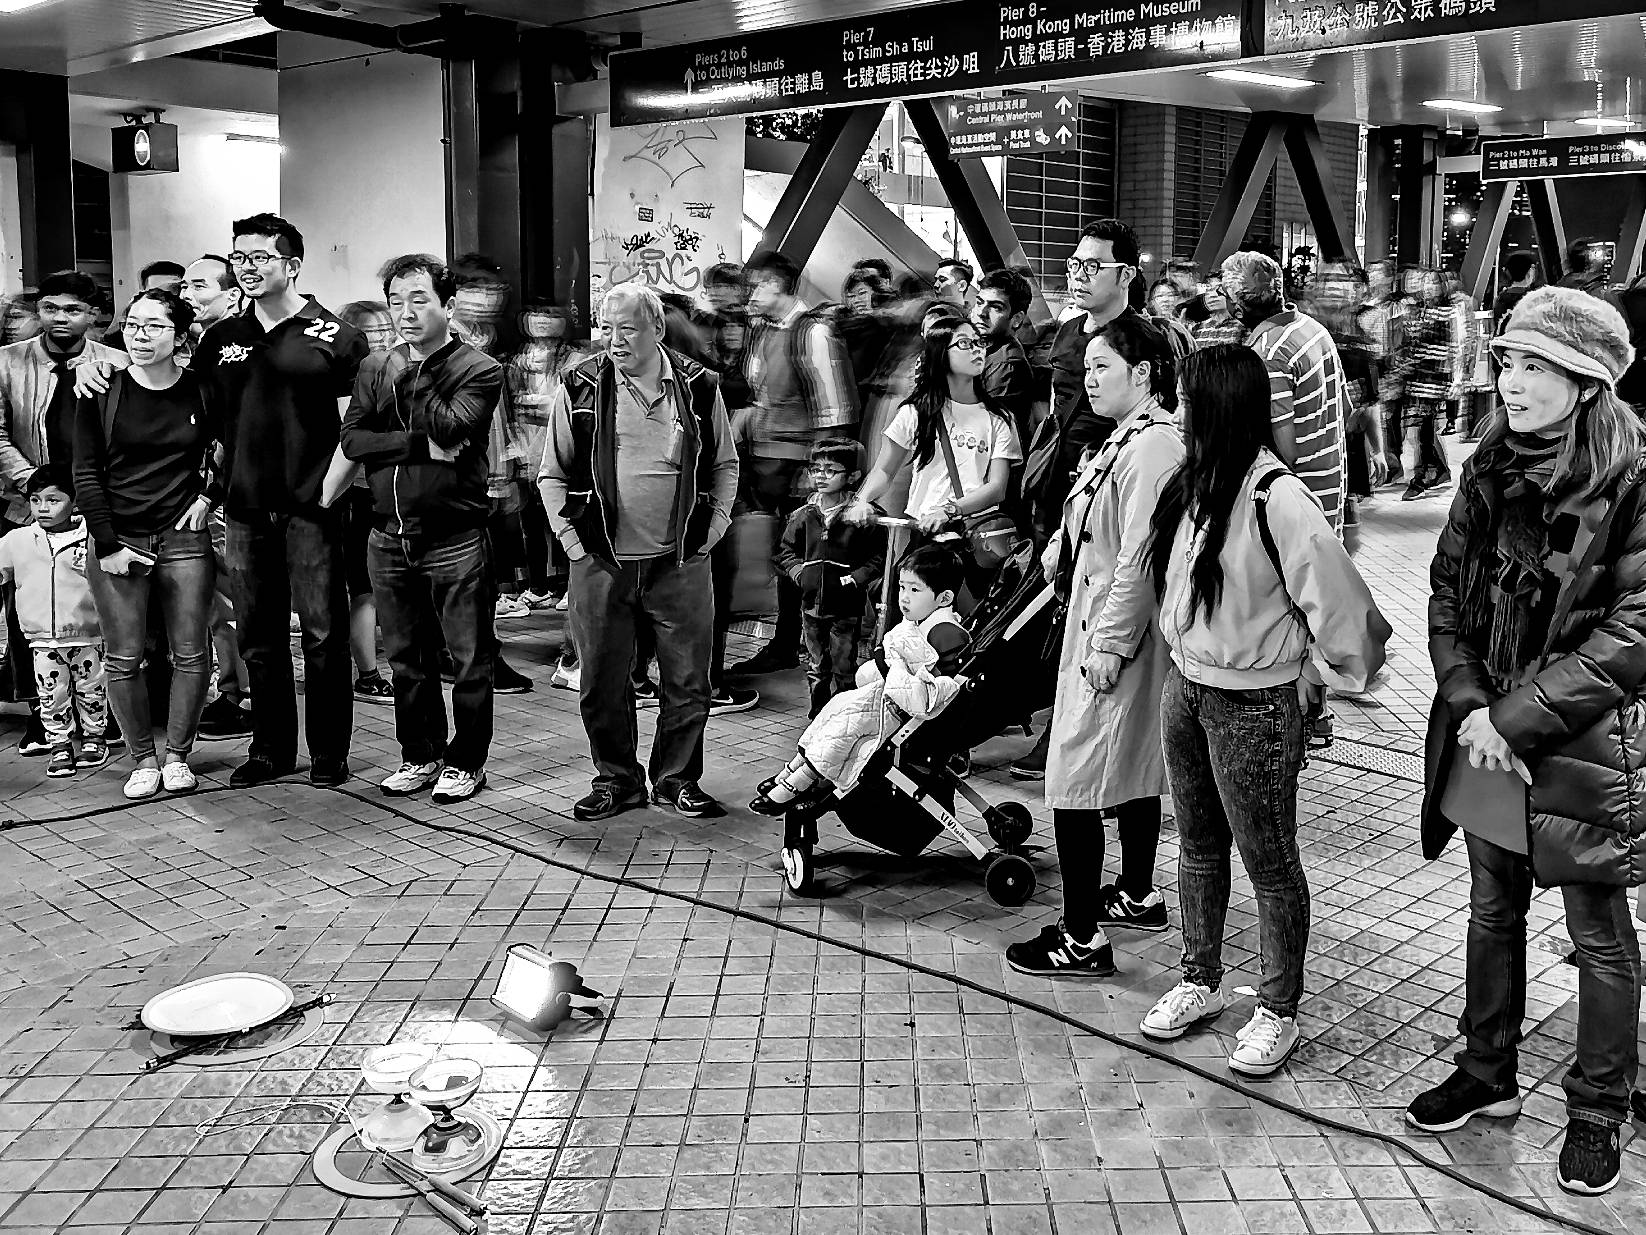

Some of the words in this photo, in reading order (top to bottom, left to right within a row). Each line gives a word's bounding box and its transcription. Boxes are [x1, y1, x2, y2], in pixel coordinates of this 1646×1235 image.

[1000, 6, 1025, 22] Pier
[1028, 2, 1037, 18] 8
[1000, 24, 1033, 40] Hong
[1036, 18, 1070, 36] Kong
[1074, 8, 1136, 29] Maritime
[1140, 0, 1201, 19] Museum
[843, 29, 865, 45] Pier
[866, 27, 875, 42] 7
[695, 53, 719, 67] Piers
[720, 50, 727, 63] 2
[729, 49, 739, 61] to
[740, 46, 748, 59] 6
[842, 48, 855, 62] to
[856, 45, 883, 60] Tsim
[911, 35, 934, 52] Tsui
[696, 69, 707, 81] to
[709, 65, 747, 80] Outlying
[749, 57, 785, 74] Islands
[842, 52, 980, 89] 七號碼頭往尖沙咀
[1489, 151, 1504, 159] Pier
[1518, 149, 1531, 157] Ma
[1531, 148, 1547, 156] Wan
[303, 317, 340, 343] 22
[1108, 902, 1126, 919] N
[1047, 948, 1071, 968] N
